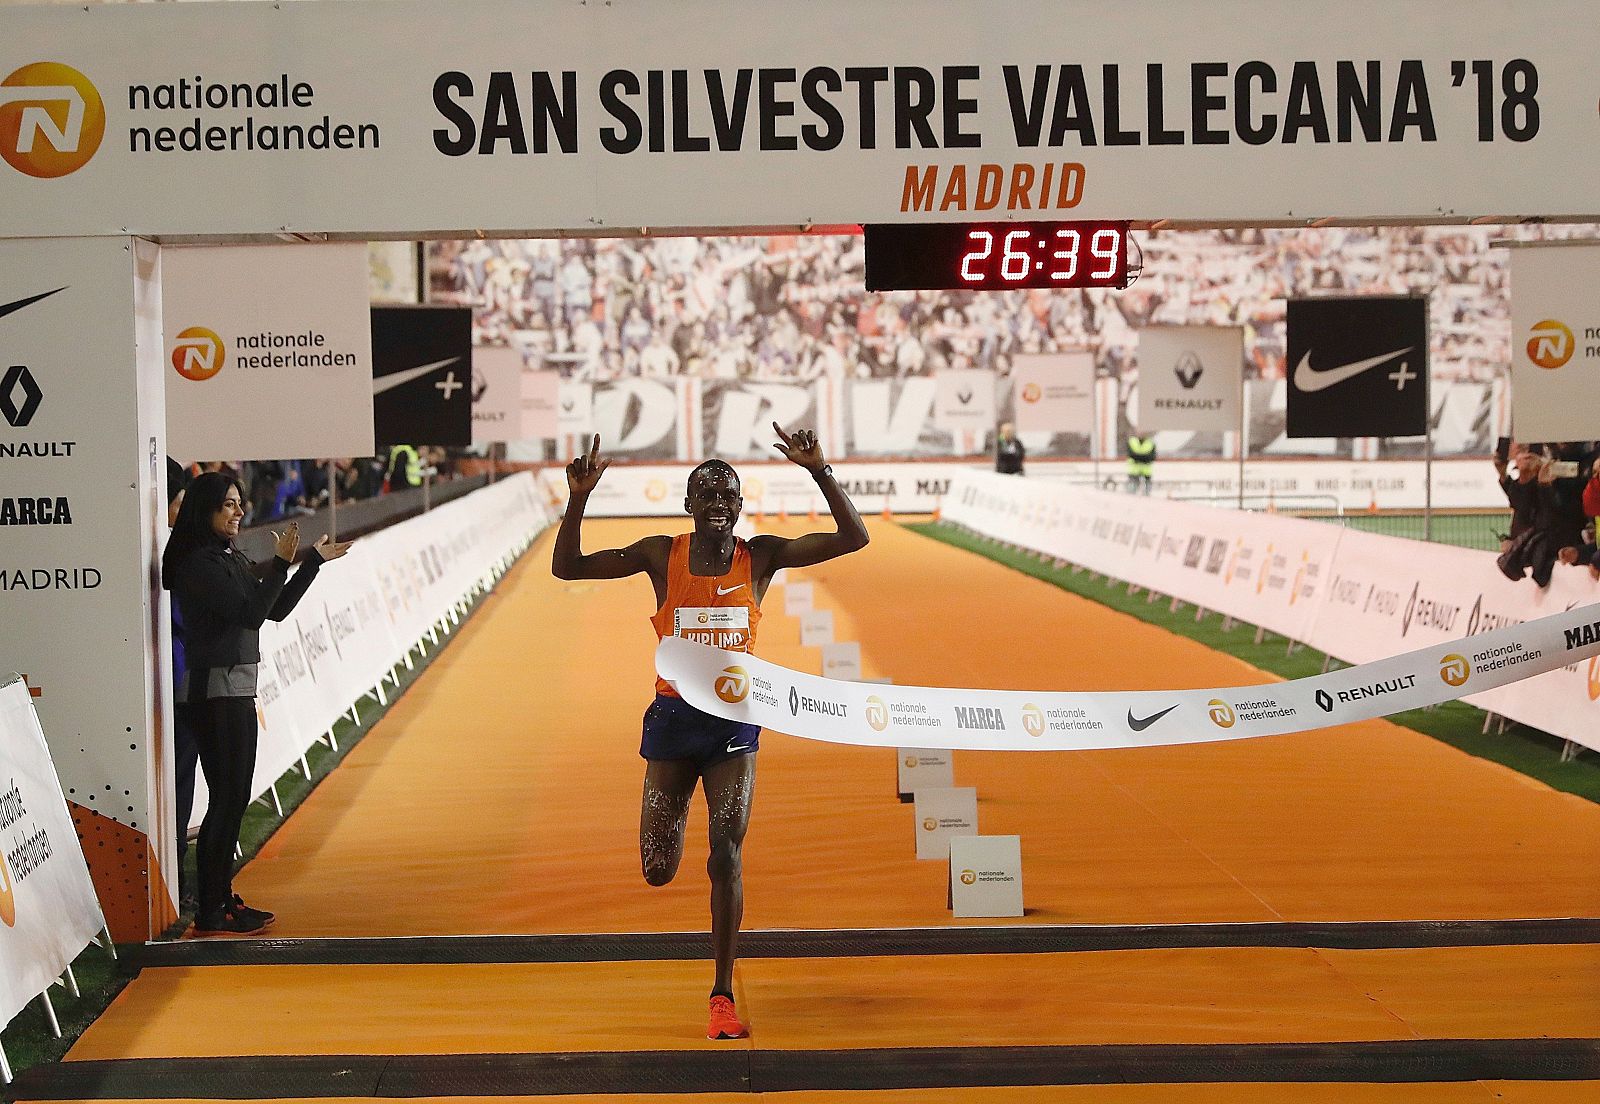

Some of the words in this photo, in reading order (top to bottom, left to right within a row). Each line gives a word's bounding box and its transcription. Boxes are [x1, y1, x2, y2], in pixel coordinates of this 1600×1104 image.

[129, 74, 314, 110] nationale
[432, 71, 578, 157] SAN
[599, 65, 982, 155] SILVESTRE
[1002, 60, 1438, 148] VALLECANA
[1450, 58, 1540, 143] '18
[129, 115, 380, 153] nederlanden
[900, 162, 1087, 213] MADRID
[961, 229, 1121, 281] 26:39
[236, 330, 325, 350] nationale
[237, 349, 357, 370] nederlanden
[1154, 399, 1224, 411] RENAULT
[1473, 641, 1523, 662] nationale
[1476, 650, 1542, 674] nederlanden
[1336, 674, 1416, 703] RENAULT
[801, 696, 848, 718] RENAULT
[890, 702, 927, 714] nationale
[1046, 708, 1086, 719] nationale
[1234, 699, 1277, 711] nationale
[1239, 708, 1297, 722] nederlanden
[892, 715, 942, 727] nederlanden
[954, 706, 1006, 731] MARCA
[1049, 720, 1104, 731] nederlanden
[7, 822, 53, 884] nederlanden
[978, 874, 1015, 882] nederlanden
